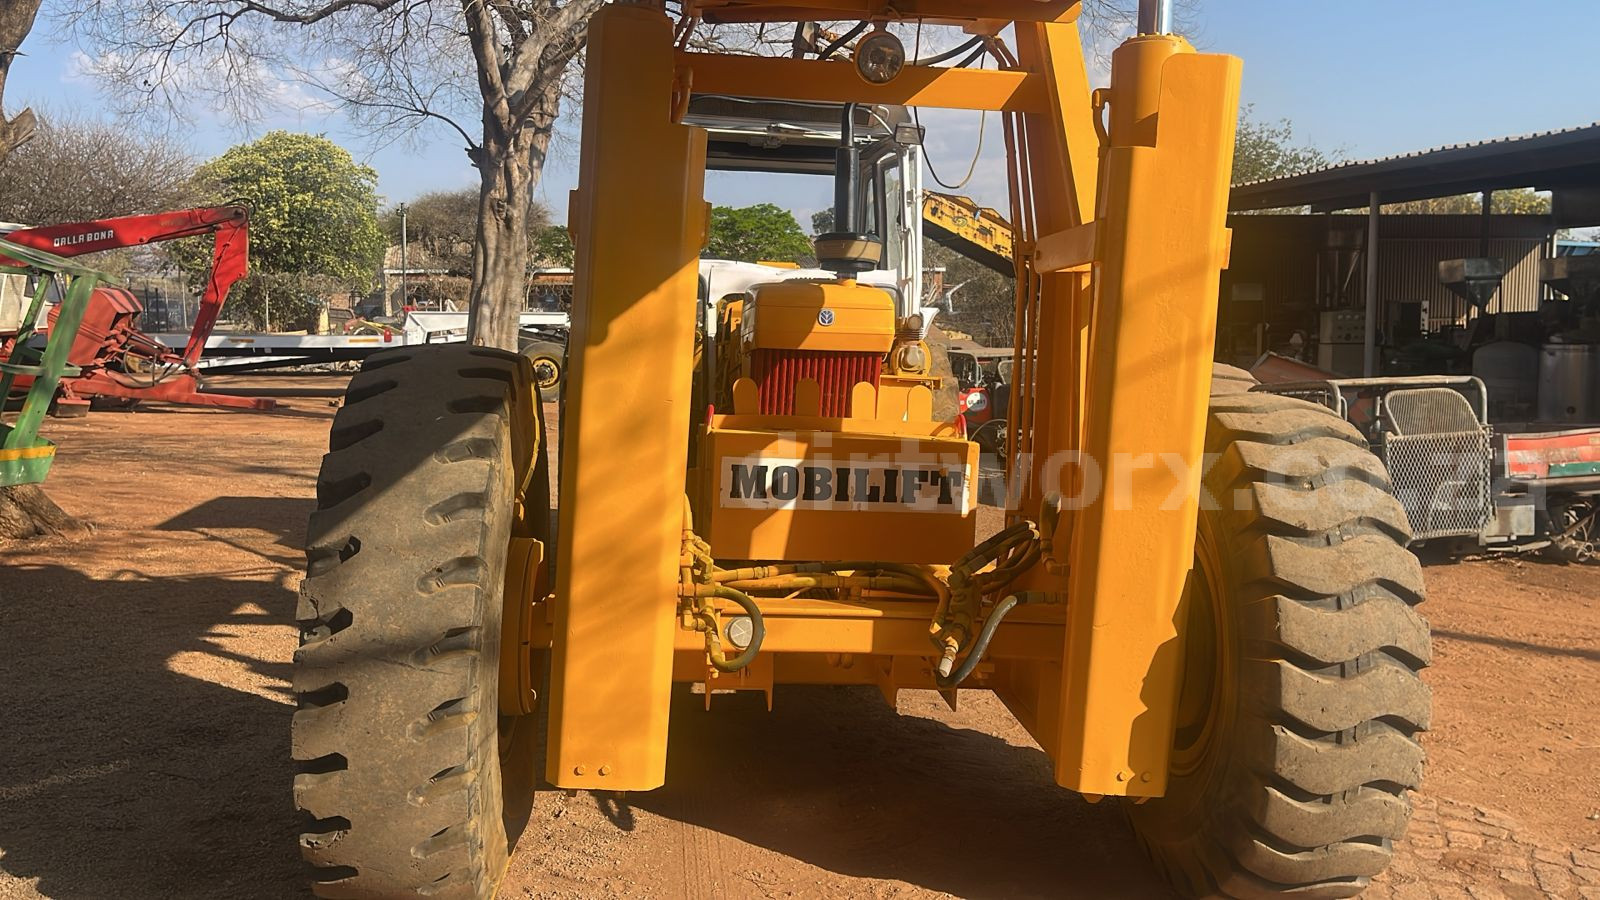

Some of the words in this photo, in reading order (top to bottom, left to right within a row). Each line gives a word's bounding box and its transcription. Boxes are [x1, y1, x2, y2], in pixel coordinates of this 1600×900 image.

[53, 233, 84, 248] DALLA
[86, 229, 114, 242] BONA
[729, 464, 963, 504] MOBILIFT
